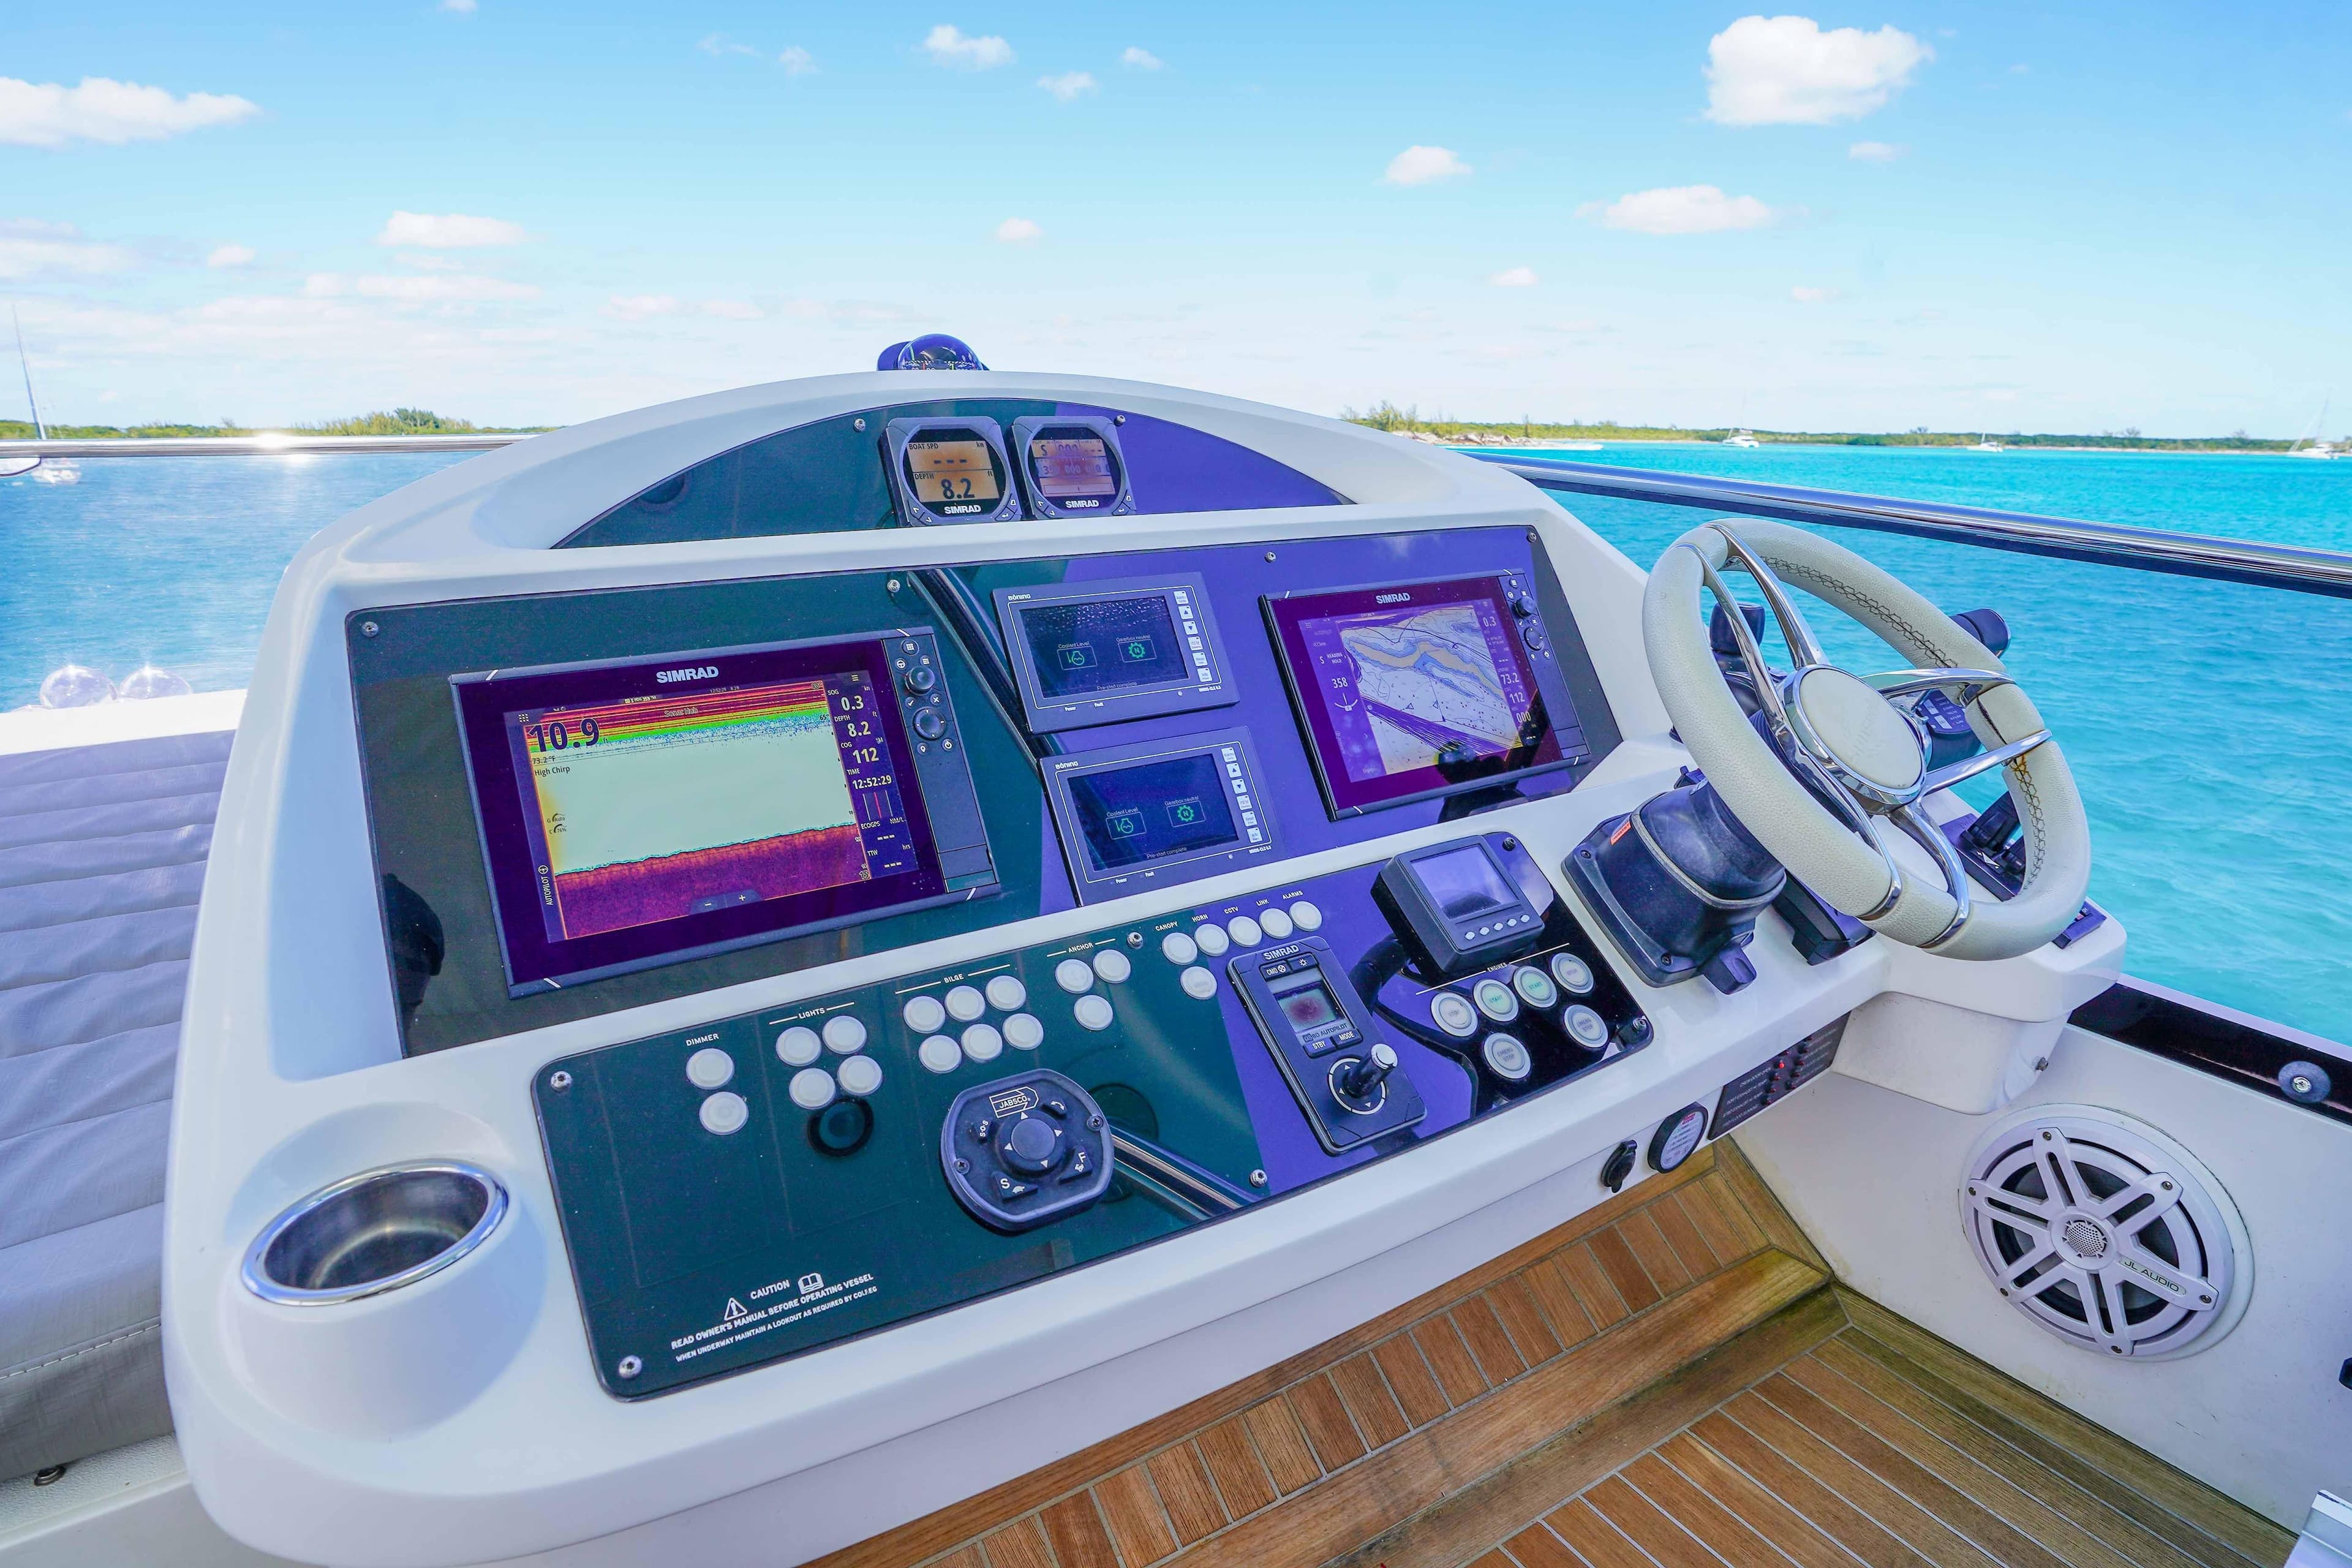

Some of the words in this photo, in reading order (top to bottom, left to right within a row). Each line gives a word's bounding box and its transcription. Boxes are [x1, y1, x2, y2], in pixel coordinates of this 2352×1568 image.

[941, 478, 975, 500] 8.2
[944, 505, 981, 514] SIMRAD
[1065, 500, 1099, 508] SIMRAD
[1376, 592, 1411, 604] SIMRAD
[1483, 616, 1496, 627] 0.3
[656, 666, 719, 684] SIMRAD
[1500, 673, 1519, 685] 73.2
[1332, 677, 1348, 688] 358
[841, 695, 864, 711] 0.3
[1510, 692, 1525, 703] 112
[1516, 710, 1531, 723] 000
[529, 718, 600, 752] 10.9
[848, 721, 871, 737] 8.2
[532, 755, 556, 764] 73.2°F
[853, 747, 880, 764] 112
[535, 768, 551, 777] High
[852, 775, 892, 790] 12:52:29
[541, 876, 554, 905] AUTOPILOT
[1283, 890, 1303, 900] ALARMS
[1192, 914, 1208, 922] HORN
[1155, 921, 1178, 932] CANOPY
[1068, 942, 1093, 953] ANCHOR
[1264, 944, 1300, 960] SIMRAD
[1487, 962, 1508, 973] ENGINES
[944, 974, 964, 984] BILGE
[799, 1008, 825, 1019] LIGHTS
[1321, 1023, 1348, 1036] AUTOPILOT
[686, 1033, 719, 1046] DIMMER
[1338, 1031, 1355, 1041] MODE
[1312, 1040, 1326, 1049] STBY
[999, 1095, 1027, 1108] JABSCO
[1077, 1152, 1087, 1163] F
[1000, 1178, 1011, 1189] S
[2125, 1261, 2138, 1270] JL
[2141, 1269, 2179, 1292] AUDIO
[750, 1280, 790, 1300] CAUTION
[671, 1335, 695, 1349] READ
[695, 1322, 733, 1341] OWNER'S
[734, 1310, 768, 1328] MANUAL
[768, 1298, 800, 1316] BEFORE
[800, 1283, 843, 1304] OPERATING
[843, 1273, 874, 1289] VESSEL
[676, 1350, 697, 1362] WHEN
[697, 1335, 734, 1355] UNDERWAY
[735, 1325, 766, 1342] MAINTAIN
[773, 1312, 802, 1329] LOOKOUT
[803, 1309, 812, 1317] AS
[813, 1298, 843, 1314] REQUIRED
[844, 1294, 853, 1303] BY
